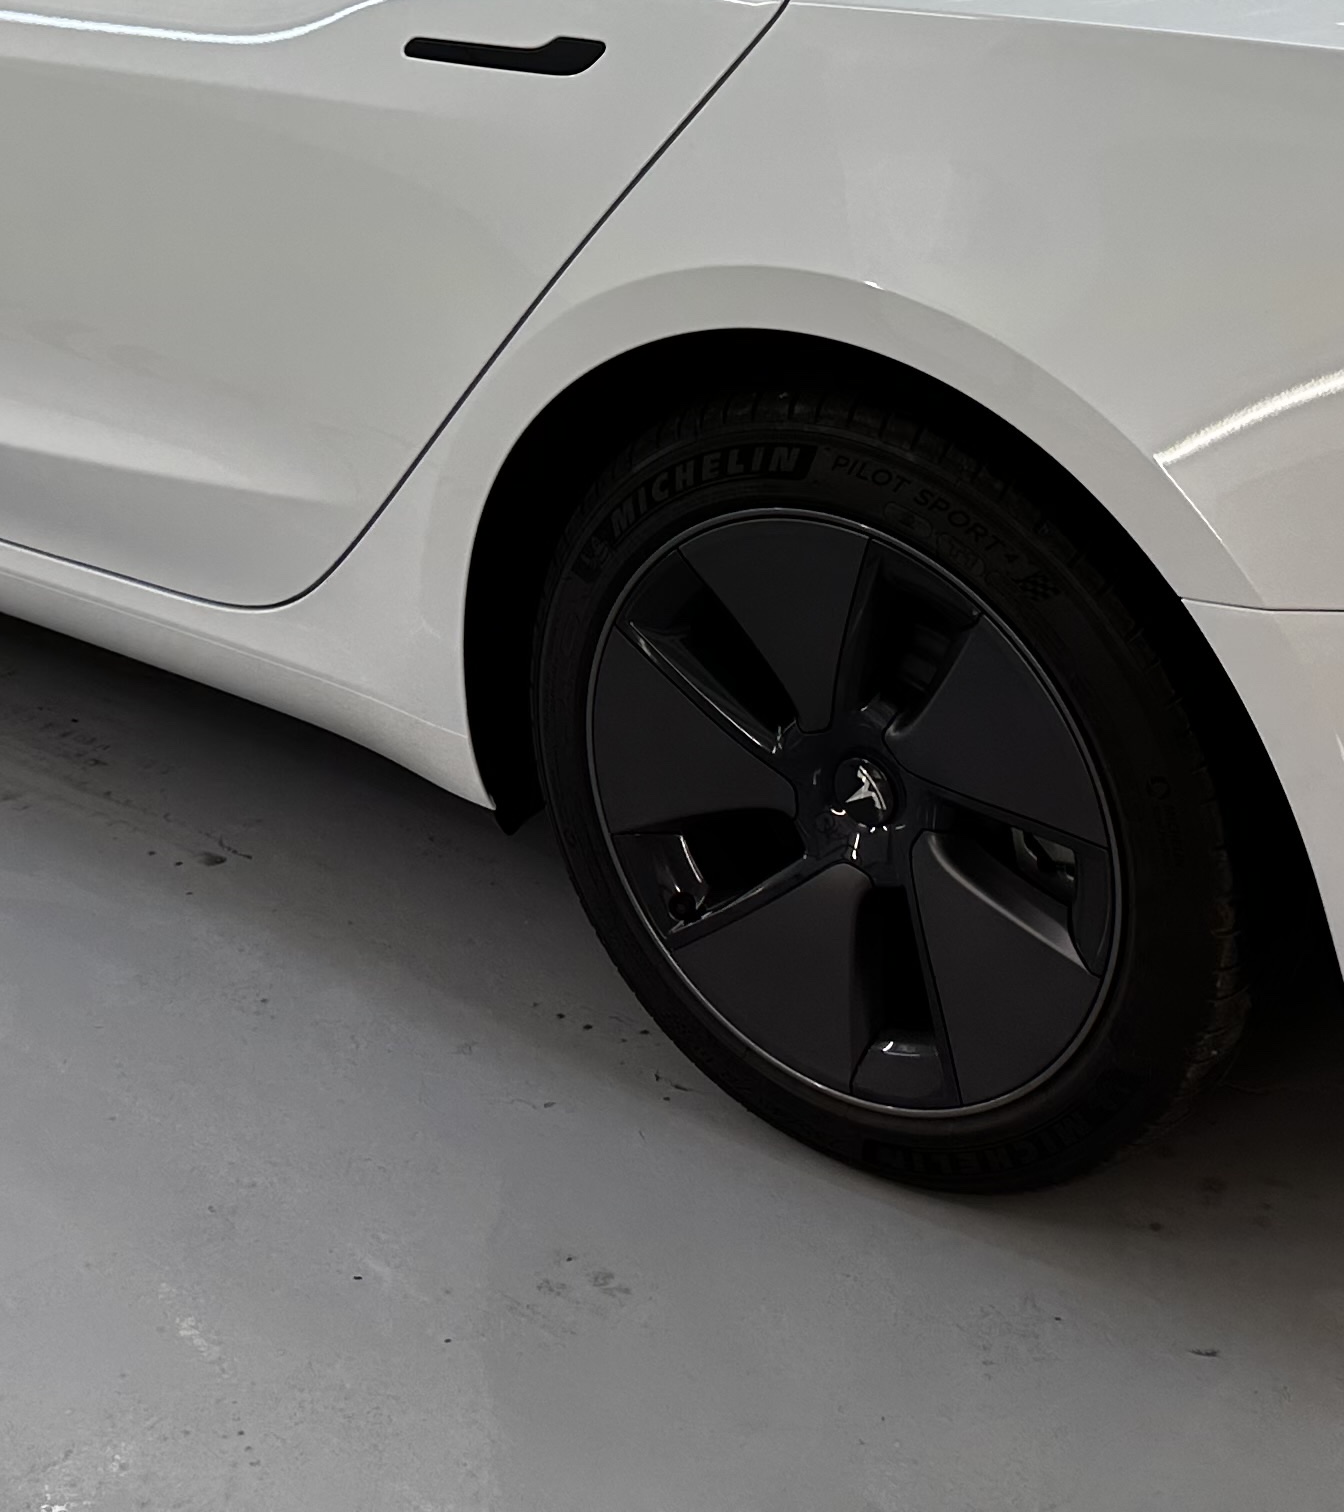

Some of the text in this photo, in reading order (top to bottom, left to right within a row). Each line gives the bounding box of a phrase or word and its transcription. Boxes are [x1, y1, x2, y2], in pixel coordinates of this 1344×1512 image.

[610, 446, 801, 540] MICHELIN
[831, 454, 911, 493] PILOT
[913, 488, 1006, 552] SPORT
